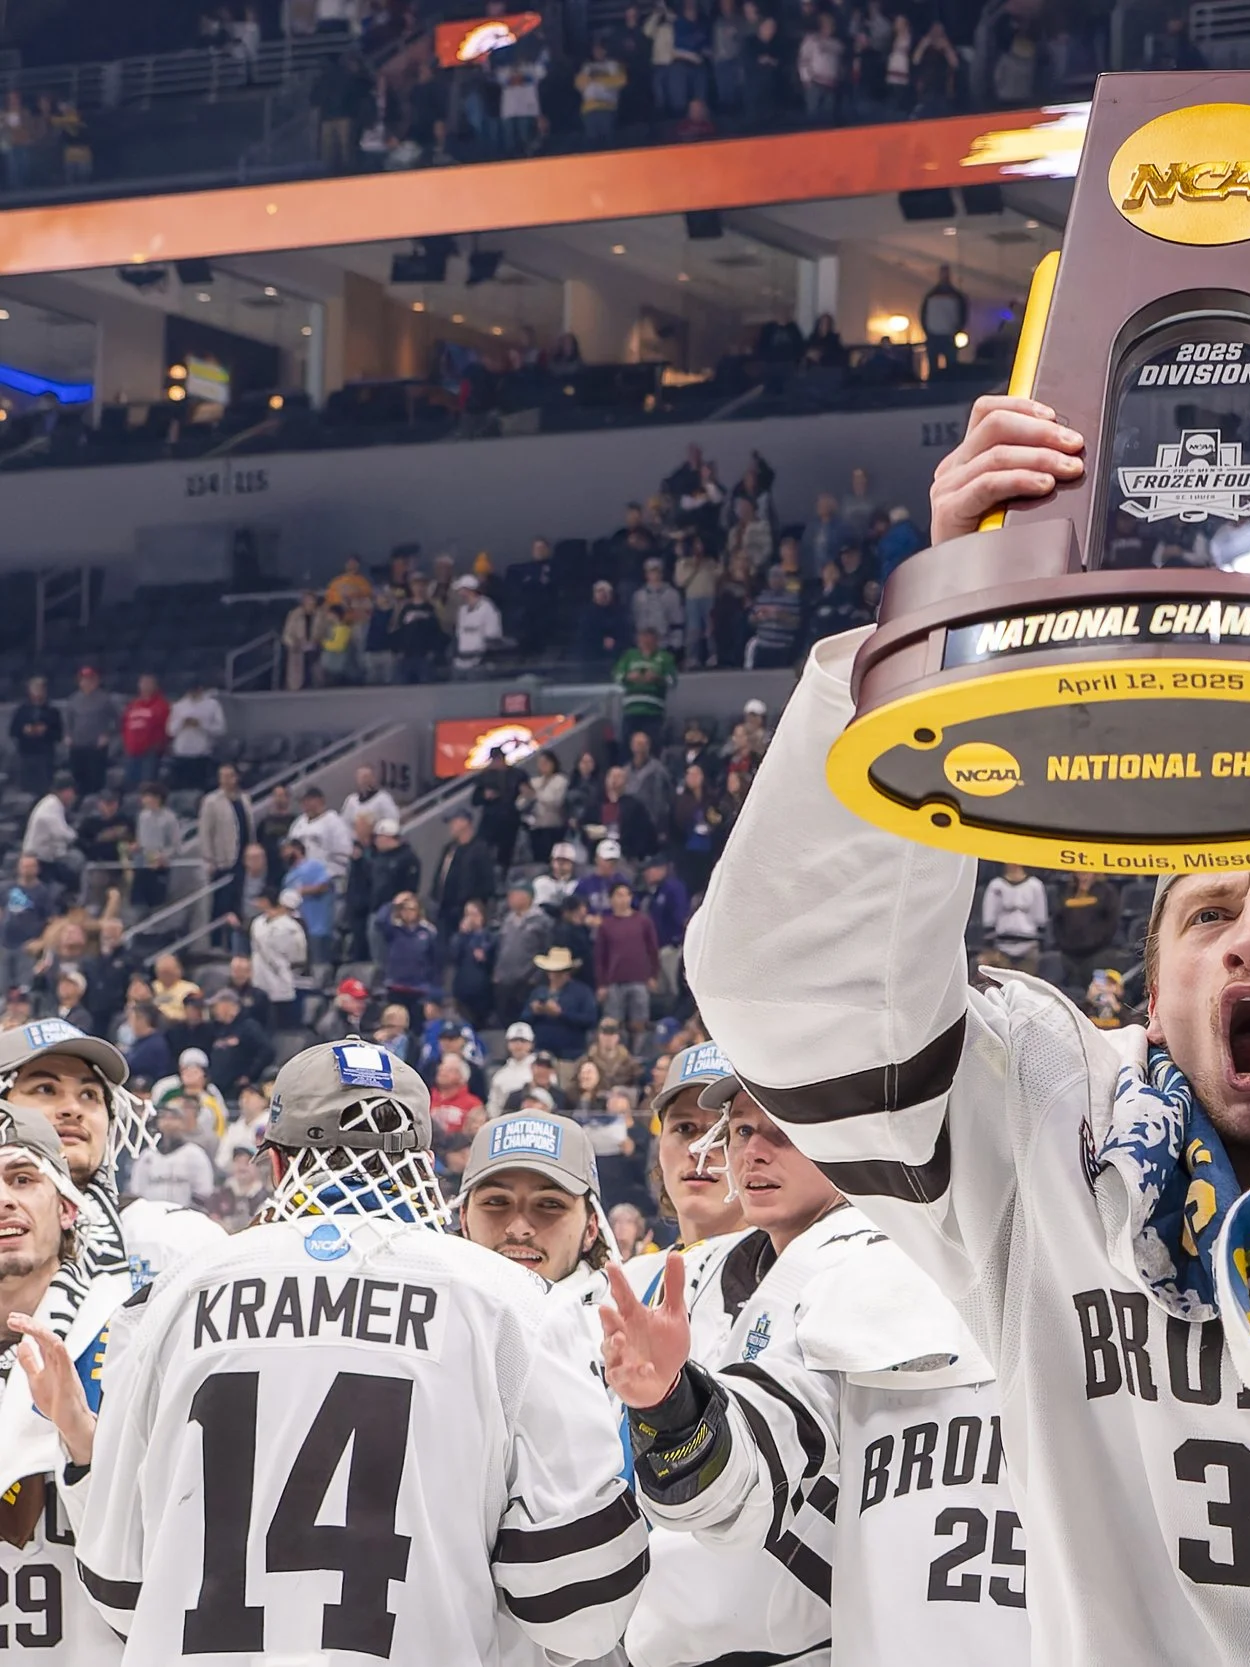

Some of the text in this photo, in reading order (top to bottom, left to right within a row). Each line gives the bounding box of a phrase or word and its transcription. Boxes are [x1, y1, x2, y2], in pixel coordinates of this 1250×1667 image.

[1176, 343, 1243, 361] 2025
[1132, 474, 1207, 489] FROZEN
[976, 604, 1140, 655] NATIONAL
[1058, 672, 1245, 696] April 12, 2025
[955, 767, 1022, 783] NCAA
[1047, 752, 1202, 782] NATIONAL
[1060, 849, 1095, 867] St.
[1103, 853, 1177, 871] Louis,
[505, 1121, 556, 1140] NATIONAL
[503, 1134, 556, 1153] CHAMPIONS
[193, 1276, 437, 1351] KRAMER
[182, 1371, 414, 1659] 14
[927, 1507, 1027, 1609] 25
